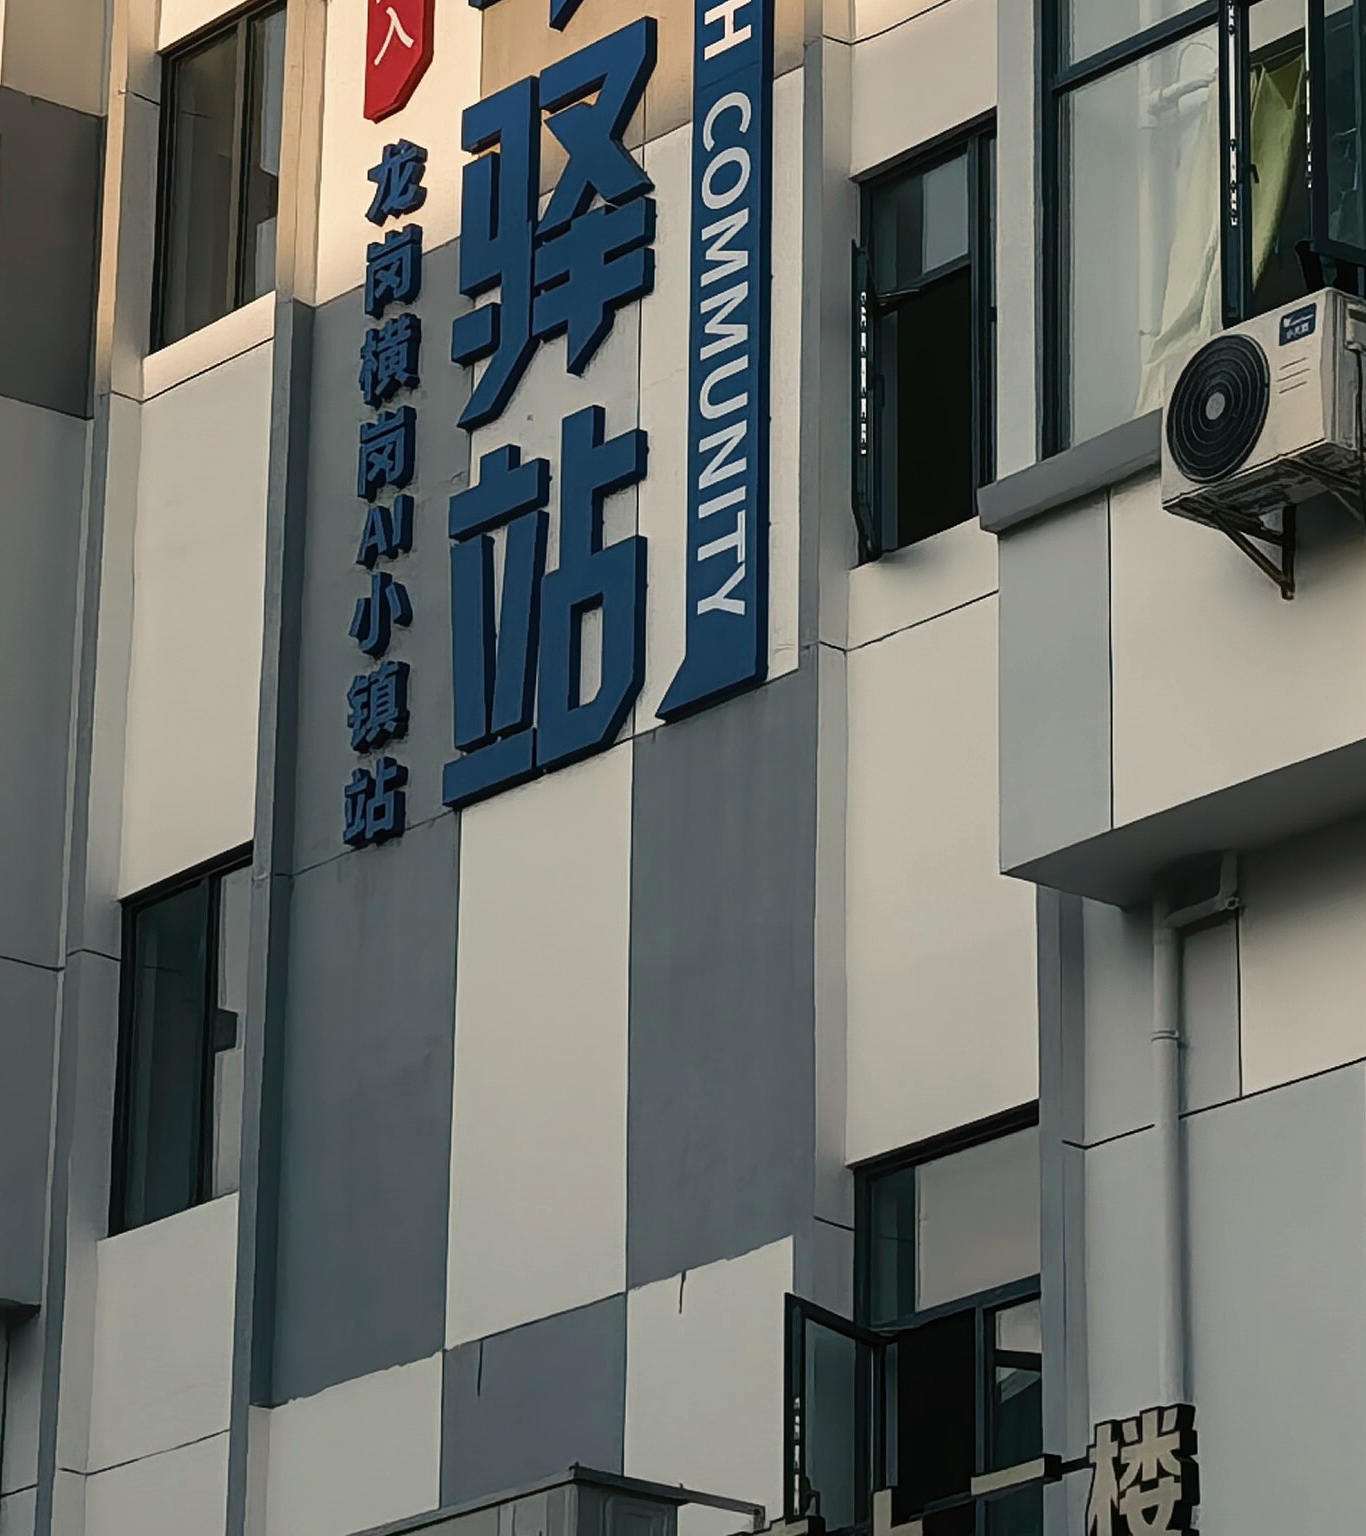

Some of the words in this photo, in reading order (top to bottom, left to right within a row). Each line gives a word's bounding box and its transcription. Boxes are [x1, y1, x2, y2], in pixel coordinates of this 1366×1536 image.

[343, 138, 428, 847] 龙岗横岗AI小镇站
[696, 90, 753, 616] COMMUNITY
